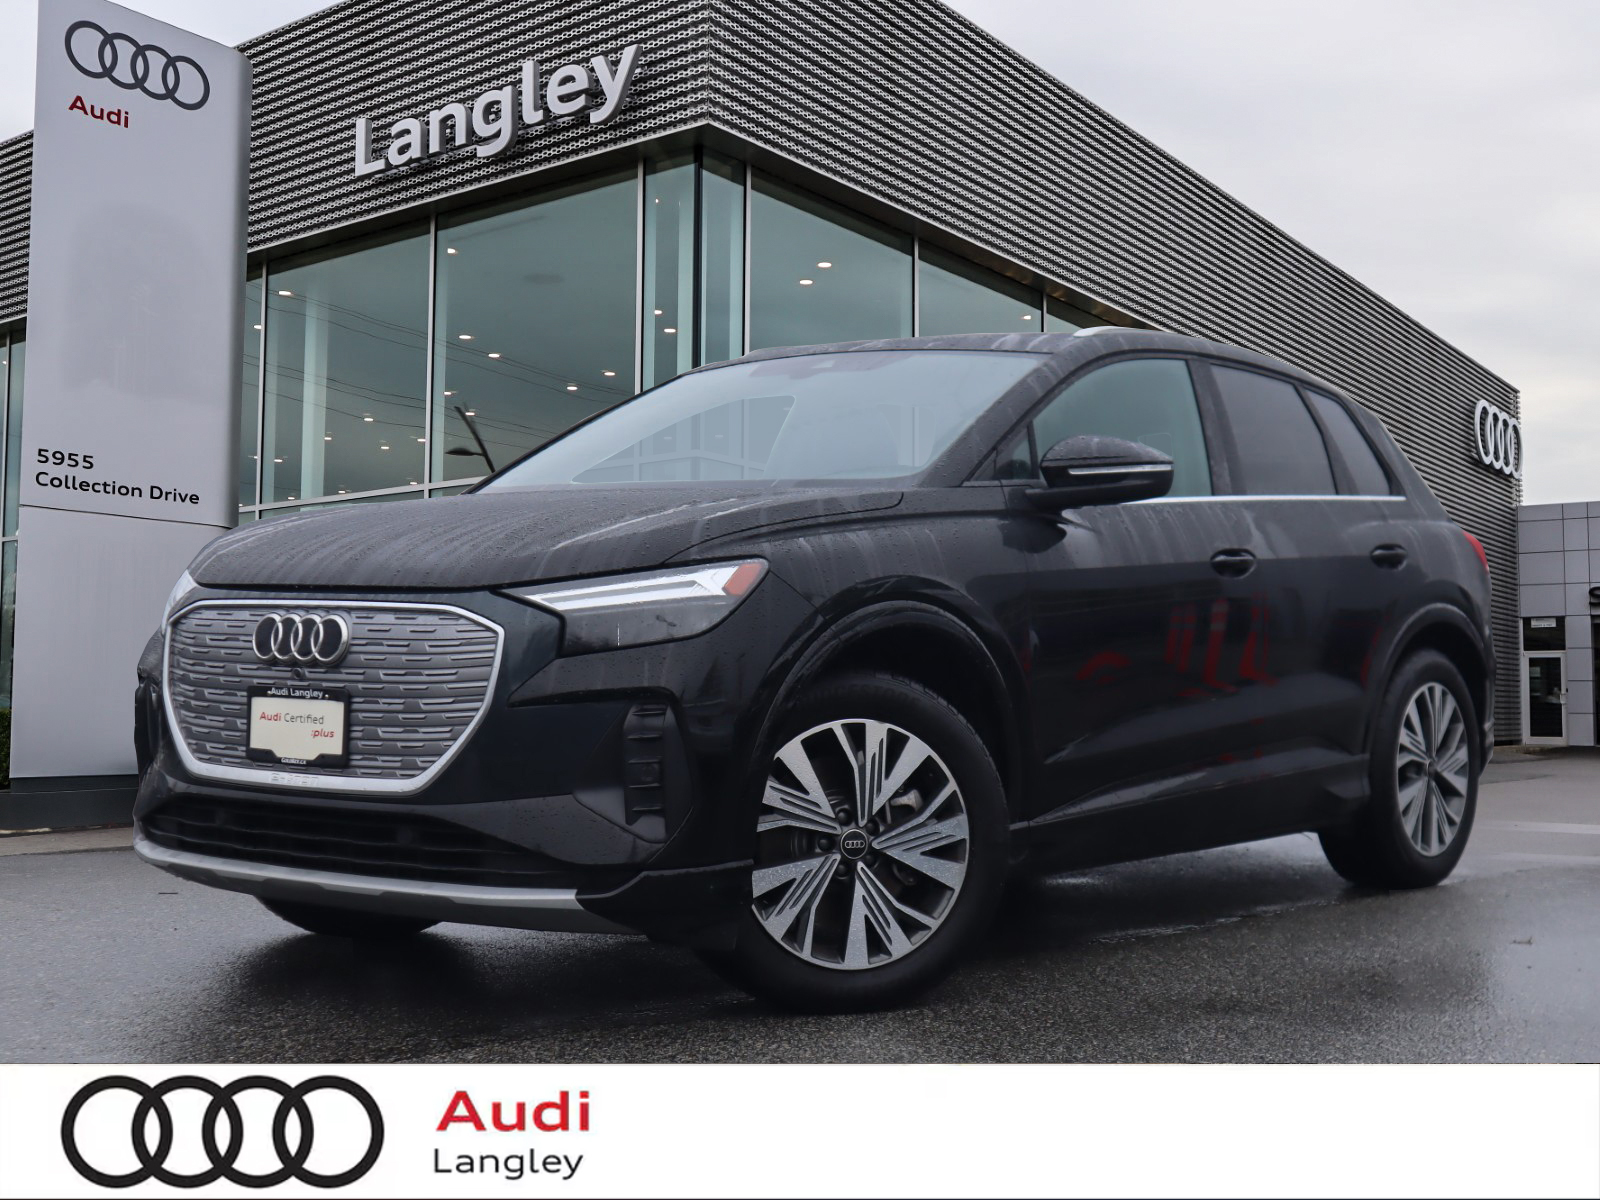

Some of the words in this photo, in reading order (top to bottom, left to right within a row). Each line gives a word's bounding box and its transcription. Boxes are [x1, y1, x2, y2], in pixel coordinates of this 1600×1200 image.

[69, 95, 129, 129] Audi
[354, 44, 643, 177] Langley
[37, 448, 94, 470] 5955
[35, 471, 143, 498] Collection
[149, 485, 200, 505] Drive
[271, 687, 288, 696] Audi
[290, 688, 323, 699] Langley
[260, 712, 281, 721] Audi
[284, 713, 324, 725] Certified
